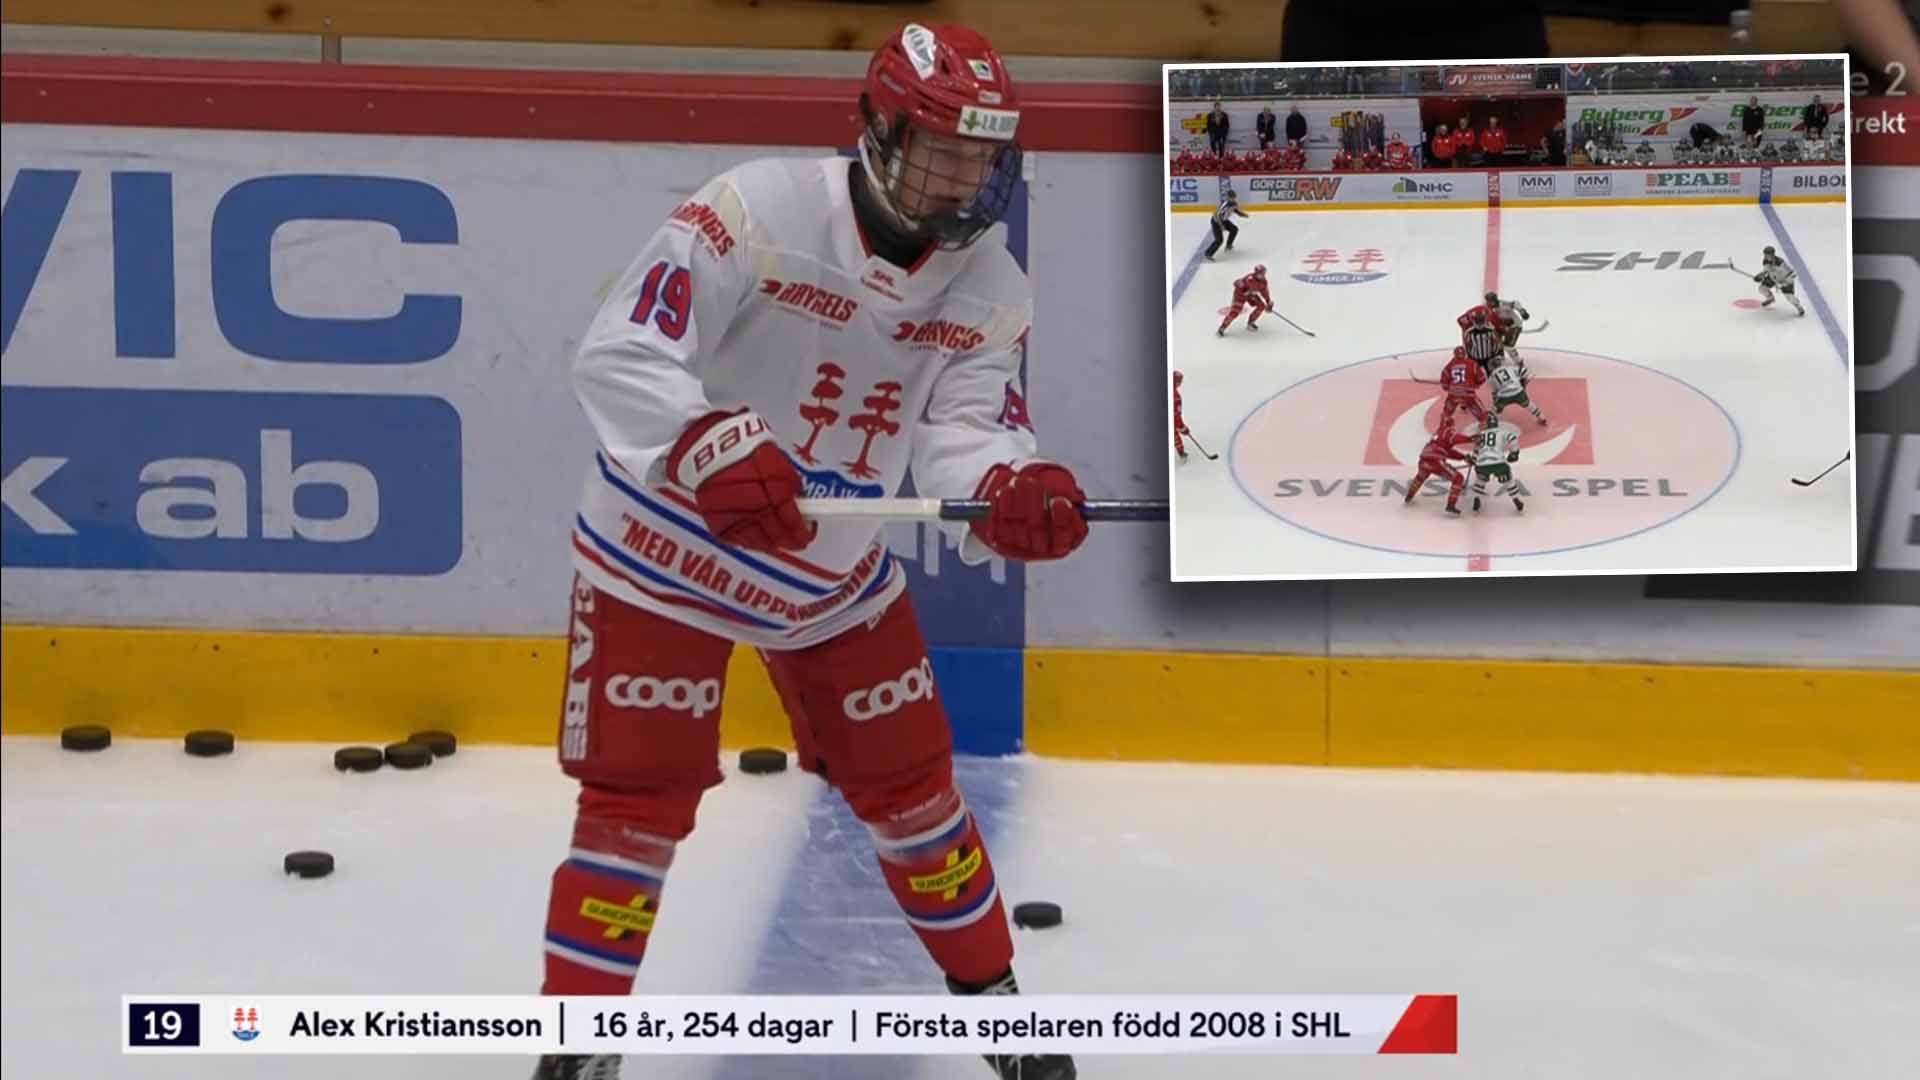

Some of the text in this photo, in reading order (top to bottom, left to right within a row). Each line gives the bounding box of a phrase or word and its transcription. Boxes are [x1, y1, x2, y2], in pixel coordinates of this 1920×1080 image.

[1296, 177, 1343, 201] RW
[1419, 182, 1453, 193] NHC
[1521, 177, 1553, 187] MM
[1577, 175, 1609, 185] MM
[1657, 173, 1729, 186] PEAB
[1556, 251, 1731, 271] SHL
[629, 260, 692, 342] 19
[1495, 368, 1511, 385] 13
[137, 429, 379, 542] ab
[1274, 478, 1688, 497] SVENSA SPEL
[679, 551, 734, 596] VÅR
[605, 674, 720, 719] coop
[843, 656, 934, 720] coop
